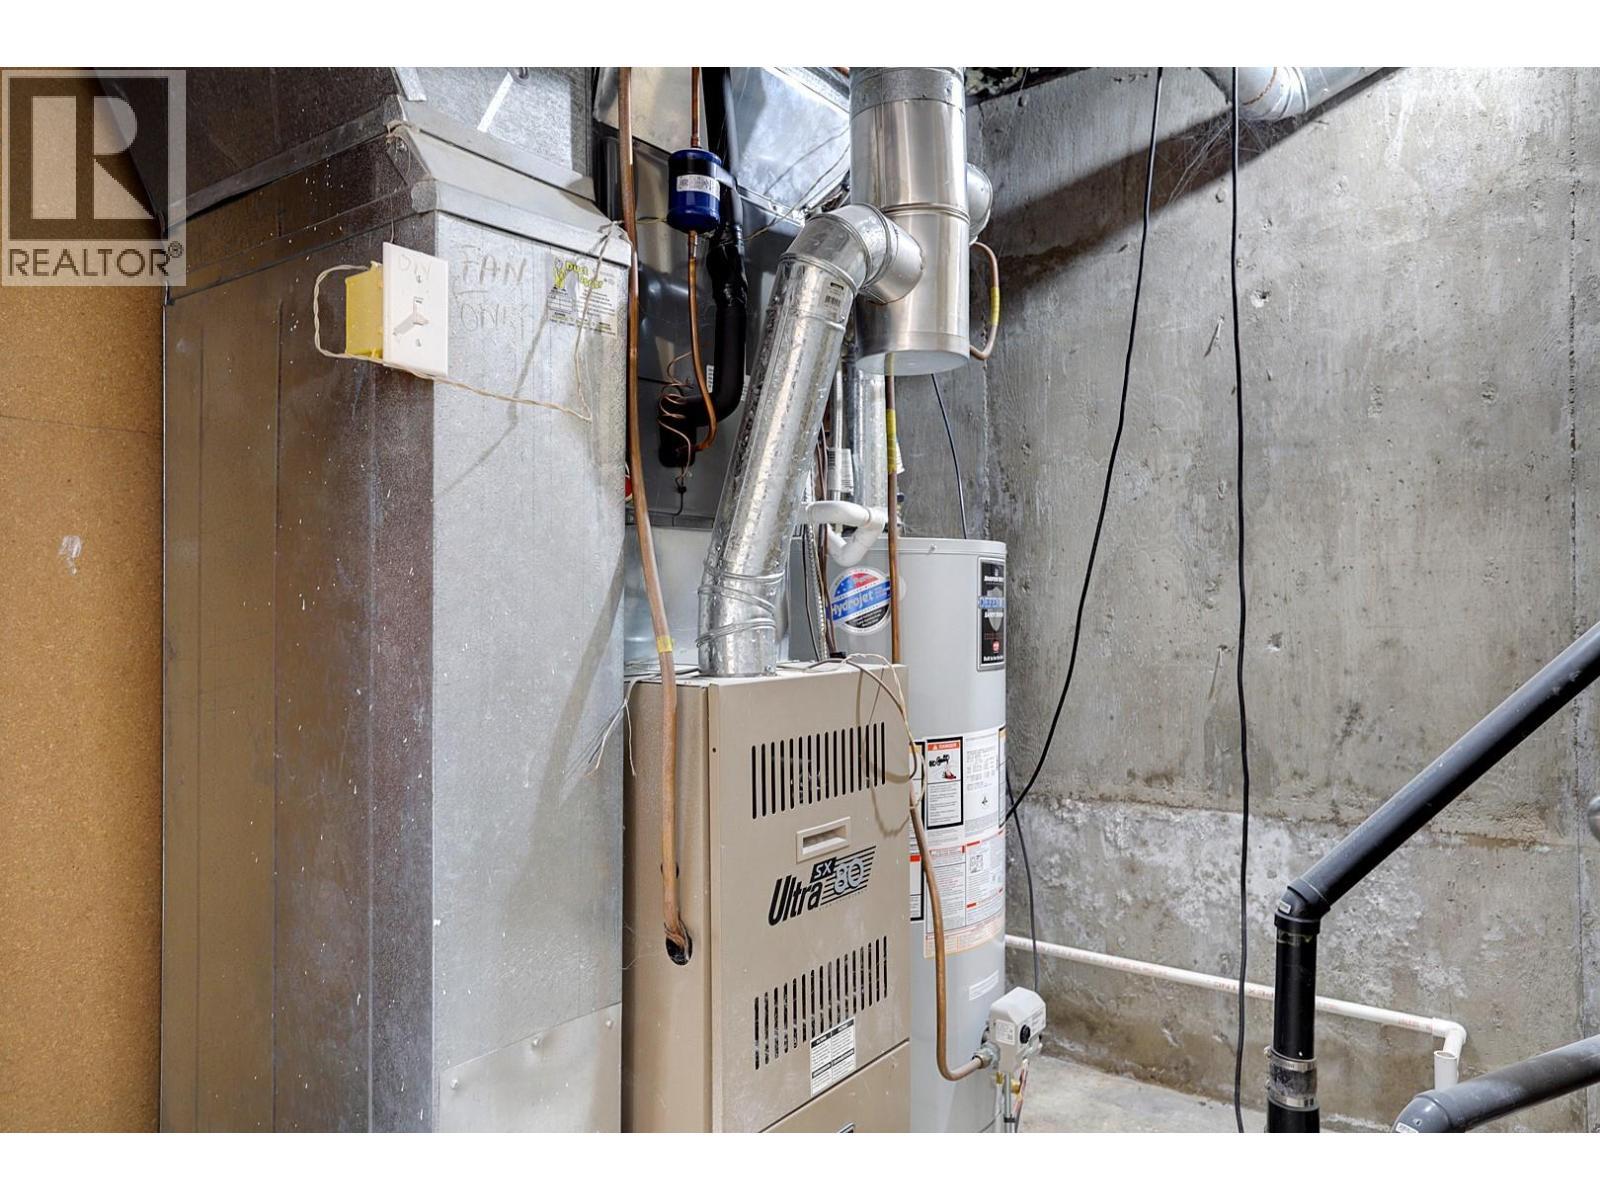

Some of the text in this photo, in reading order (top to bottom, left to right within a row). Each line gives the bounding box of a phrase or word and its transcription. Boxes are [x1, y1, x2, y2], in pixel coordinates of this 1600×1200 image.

[460, 244, 527, 285] FAN
[831, 590, 874, 617] Hydrojet
[814, 859, 833, 879] SX
[768, 874, 823, 926] Ultra
[833, 857, 865, 896] 80
